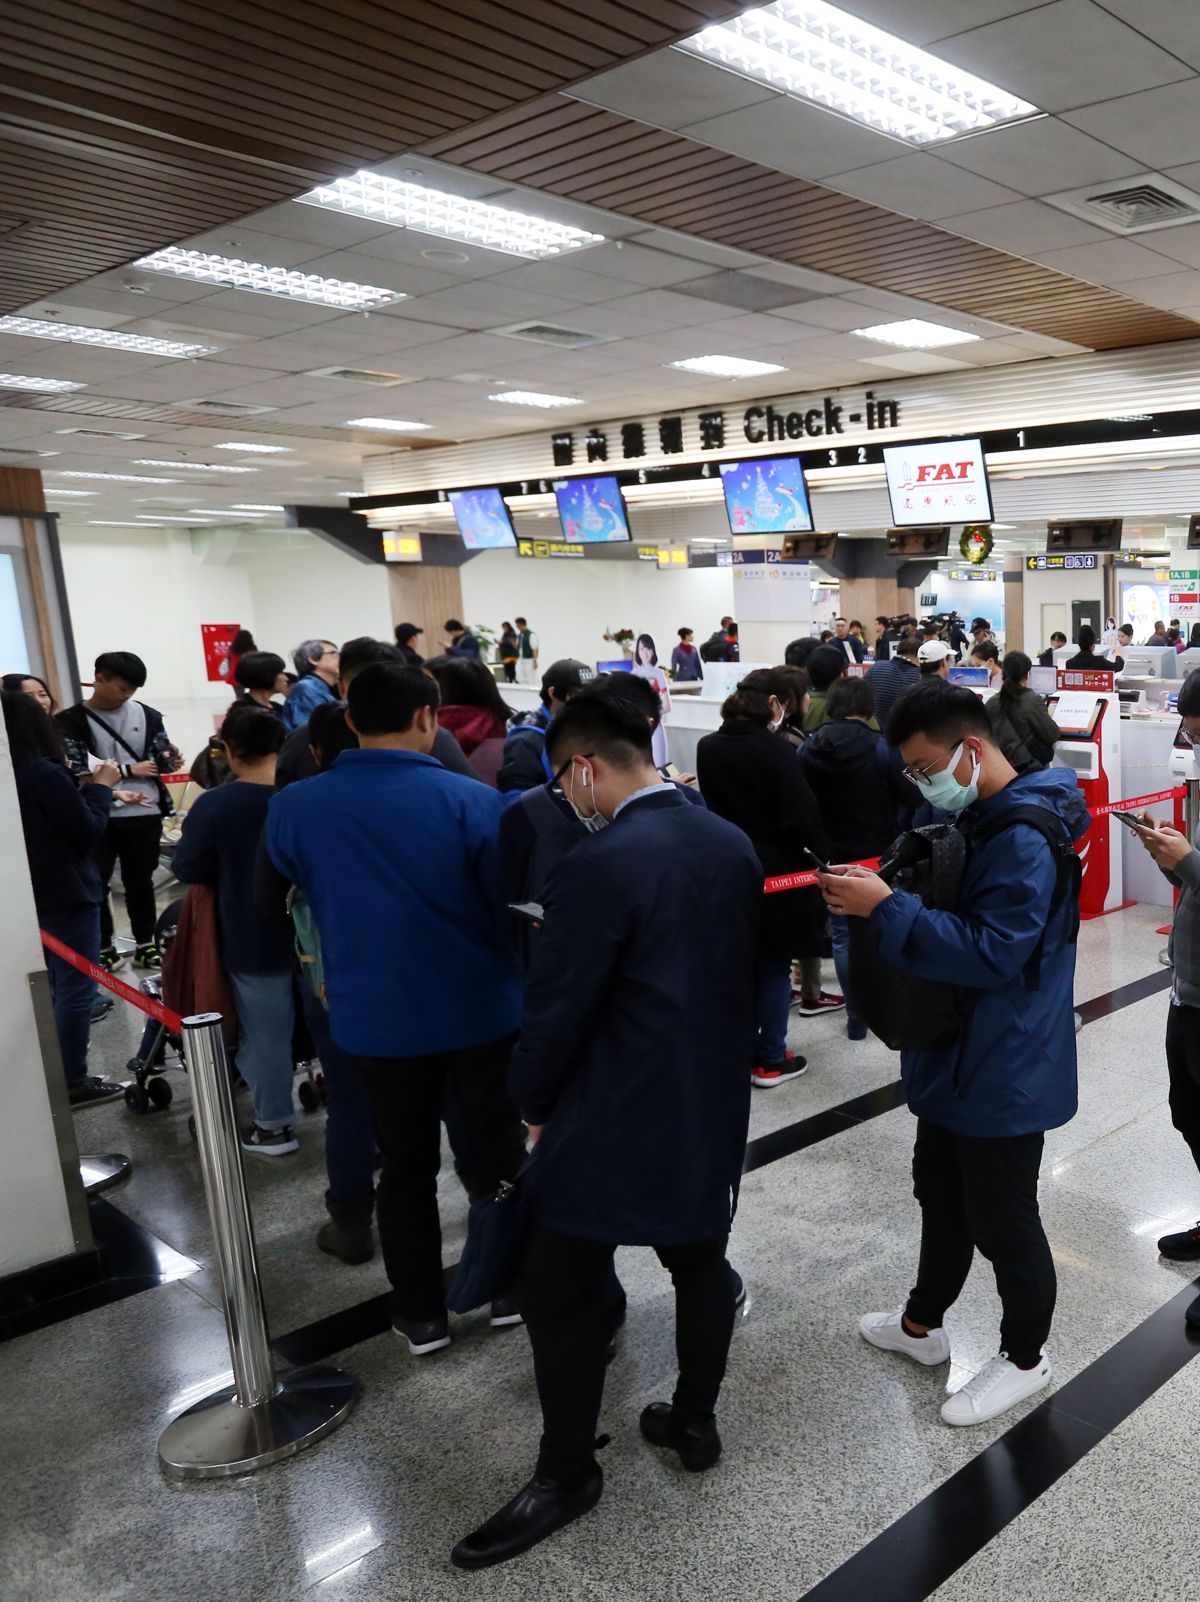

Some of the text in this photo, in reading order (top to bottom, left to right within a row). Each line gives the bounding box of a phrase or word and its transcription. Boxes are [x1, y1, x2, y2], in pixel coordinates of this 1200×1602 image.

[743, 391, 899, 444] Check-in
[1016, 430, 1026, 448] 1
[828, 450, 838, 466] 3
[857, 447, 867, 463] 2
[638, 469, 648, 484] 5
[916, 461, 974, 482] FAT
[732, 552, 745, 564] 2A
[767, 551, 782, 563] 2A
[1170, 594, 1180, 602] 1B
[770, 877, 793, 889] TAIPEI
